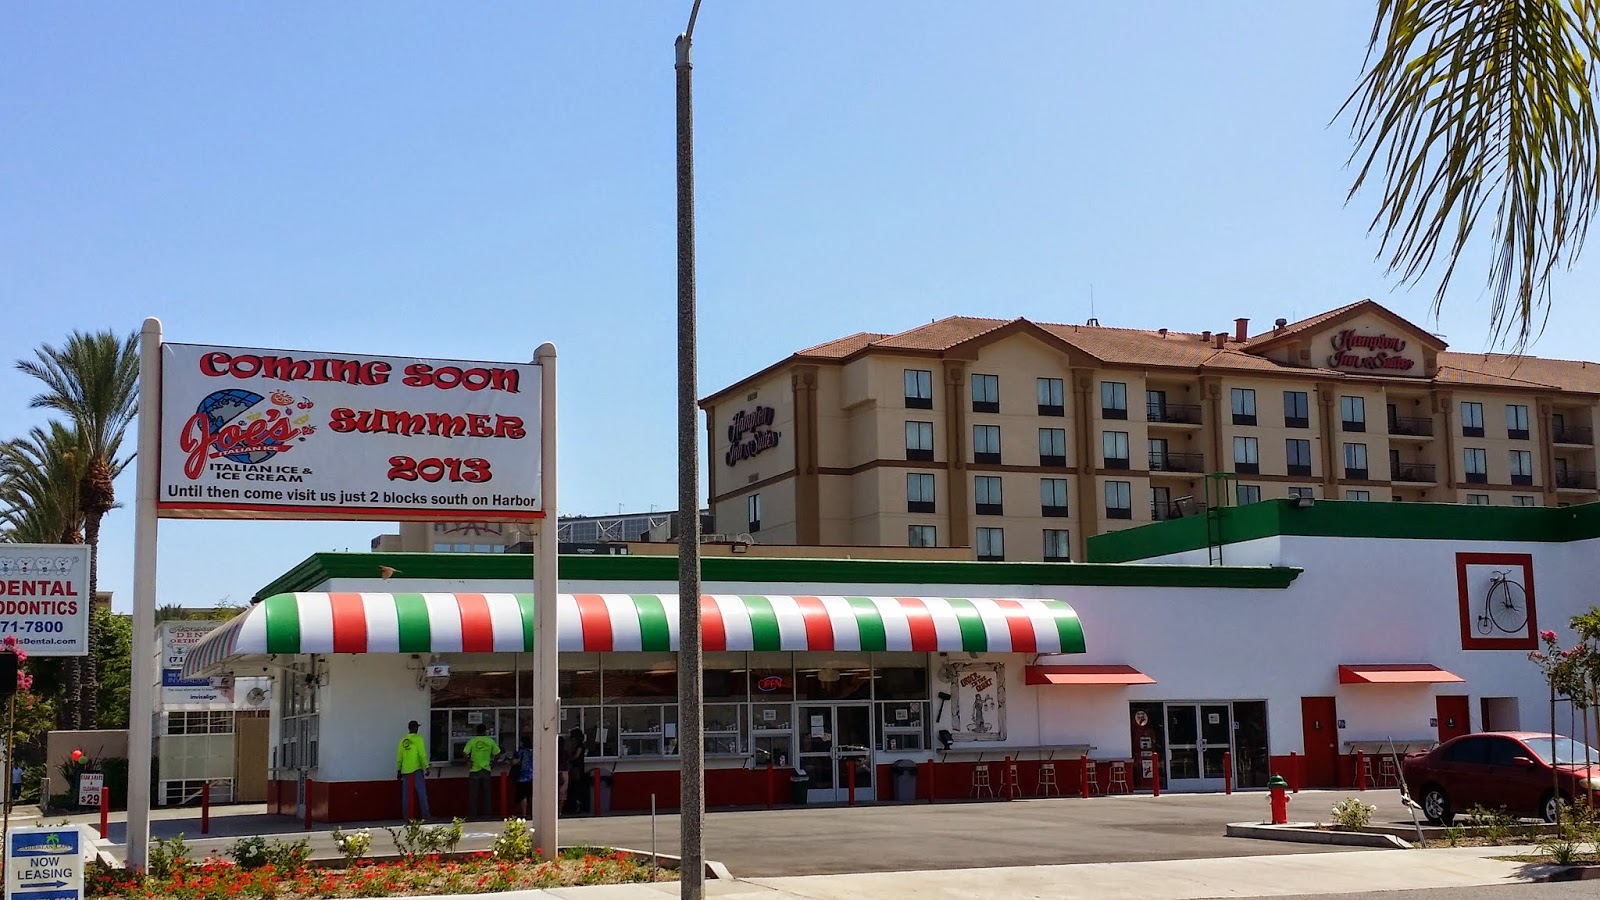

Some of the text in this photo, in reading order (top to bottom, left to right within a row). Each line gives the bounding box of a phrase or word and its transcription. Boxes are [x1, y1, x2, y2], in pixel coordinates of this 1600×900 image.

[1331, 328, 1406, 352] Hampton
[1327, 350, 1361, 369] Inn
[1375, 352, 1414, 370] Suites
[200, 351, 521, 394] COMING SOON
[329, 407, 527, 440] SUMMER
[728, 405, 775, 443] Hampton
[180, 408, 301, 480] Joe's
[219, 446, 257, 456] ITALIAN
[210, 463, 313, 475] ITALIAN ICE &
[216, 472, 303, 483] ICE CREAM
[387, 455, 493, 483] 2013
[168, 484, 536, 507] Until then come visit us just 2 blocks south on Harbor
[758, 679, 782, 689] OPEN
[81, 793, 100, 805] $29
[31, 857, 60, 868] NOW
[17, 868, 73, 881] LEASING
